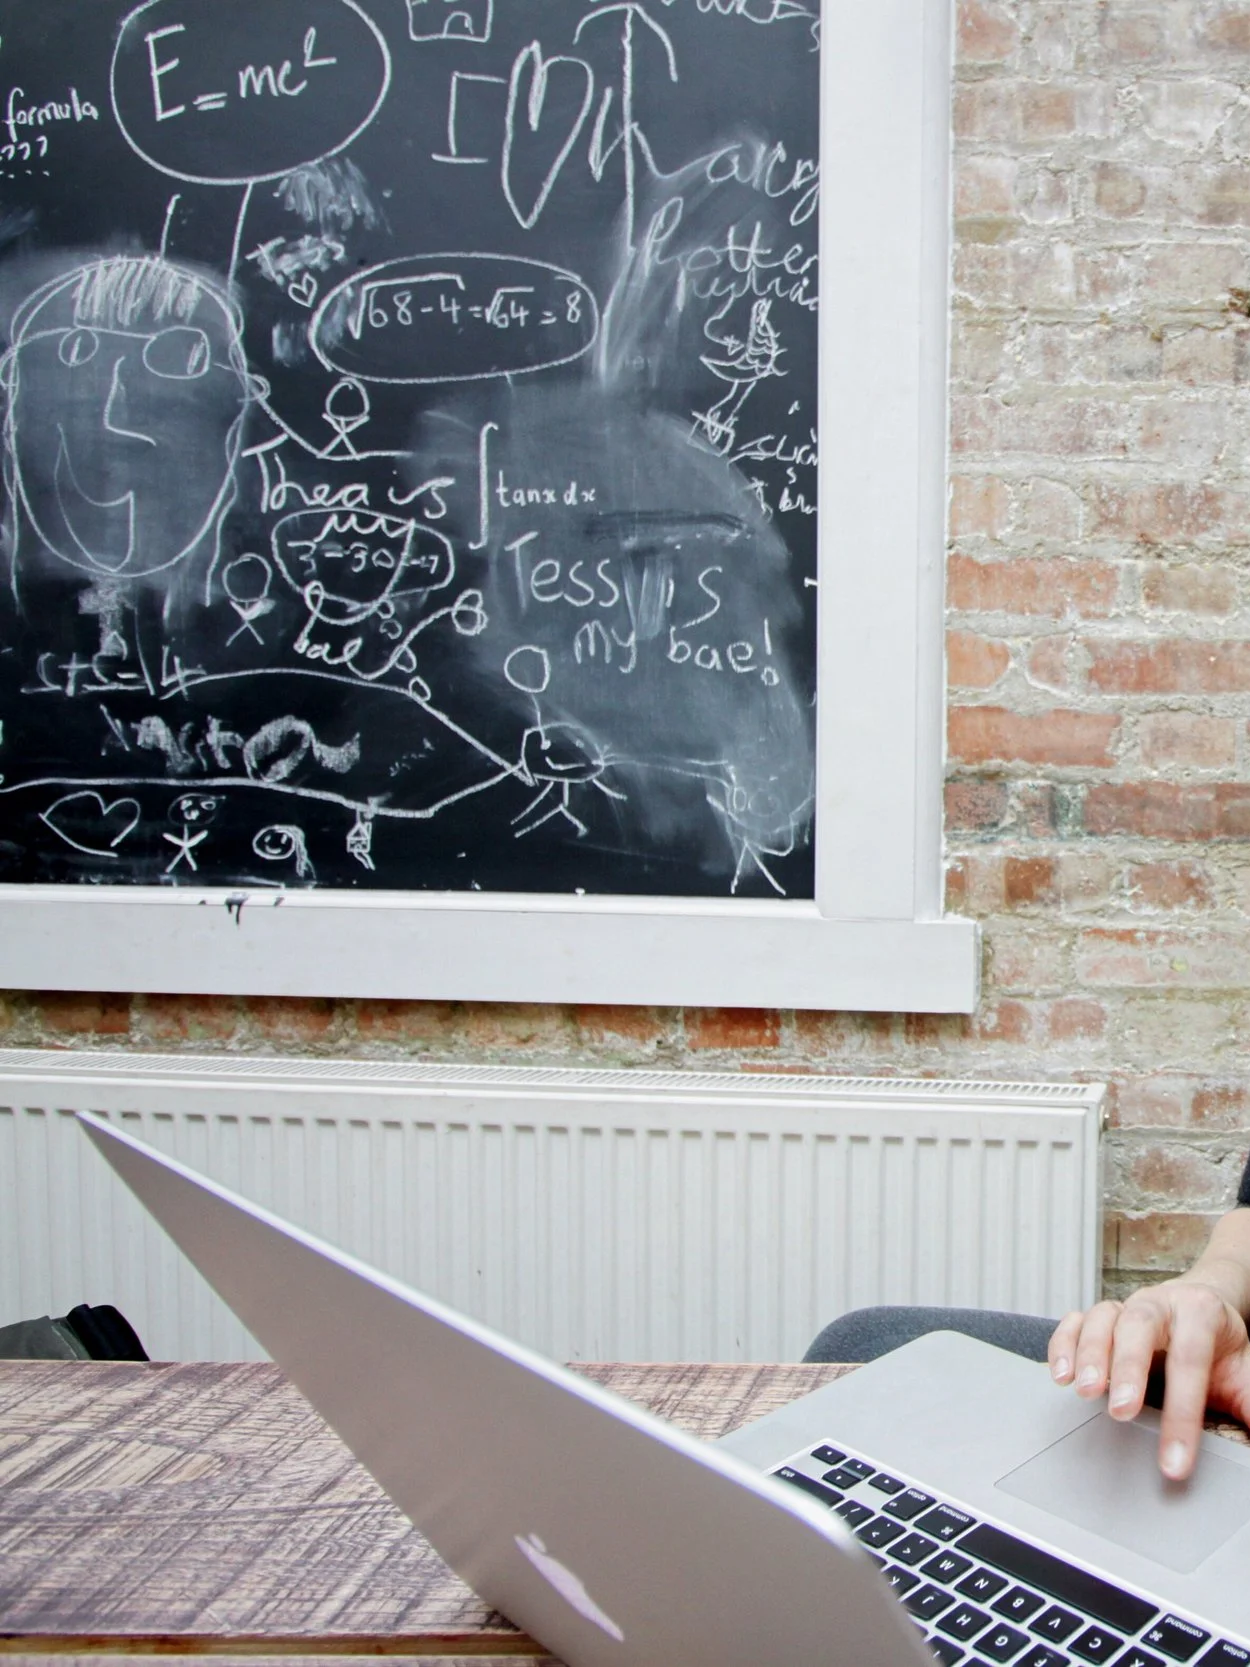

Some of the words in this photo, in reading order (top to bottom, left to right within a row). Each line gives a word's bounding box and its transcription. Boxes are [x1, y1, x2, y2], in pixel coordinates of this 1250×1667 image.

[4, 86, 99, 143] formula
[242, 434, 370, 513] Thea
[504, 532, 619, 614] Tess
[666, 566, 722, 628] is
[573, 619, 636, 674] my
[668, 618, 780, 686] bae!
[938, 1505, 970, 1524] command
[940, 1559, 955, 1571] M
[975, 1578, 989, 1590] N
[1012, 1597, 1025, 1609] B
[956, 1613, 972, 1625] H
[1048, 1617, 1061, 1628] V
[1164, 1615, 1204, 1639] command
[994, 1635, 1009, 1647] G
[1088, 1636, 1102, 1648] C
[1222, 1643, 1249, 1661] option
